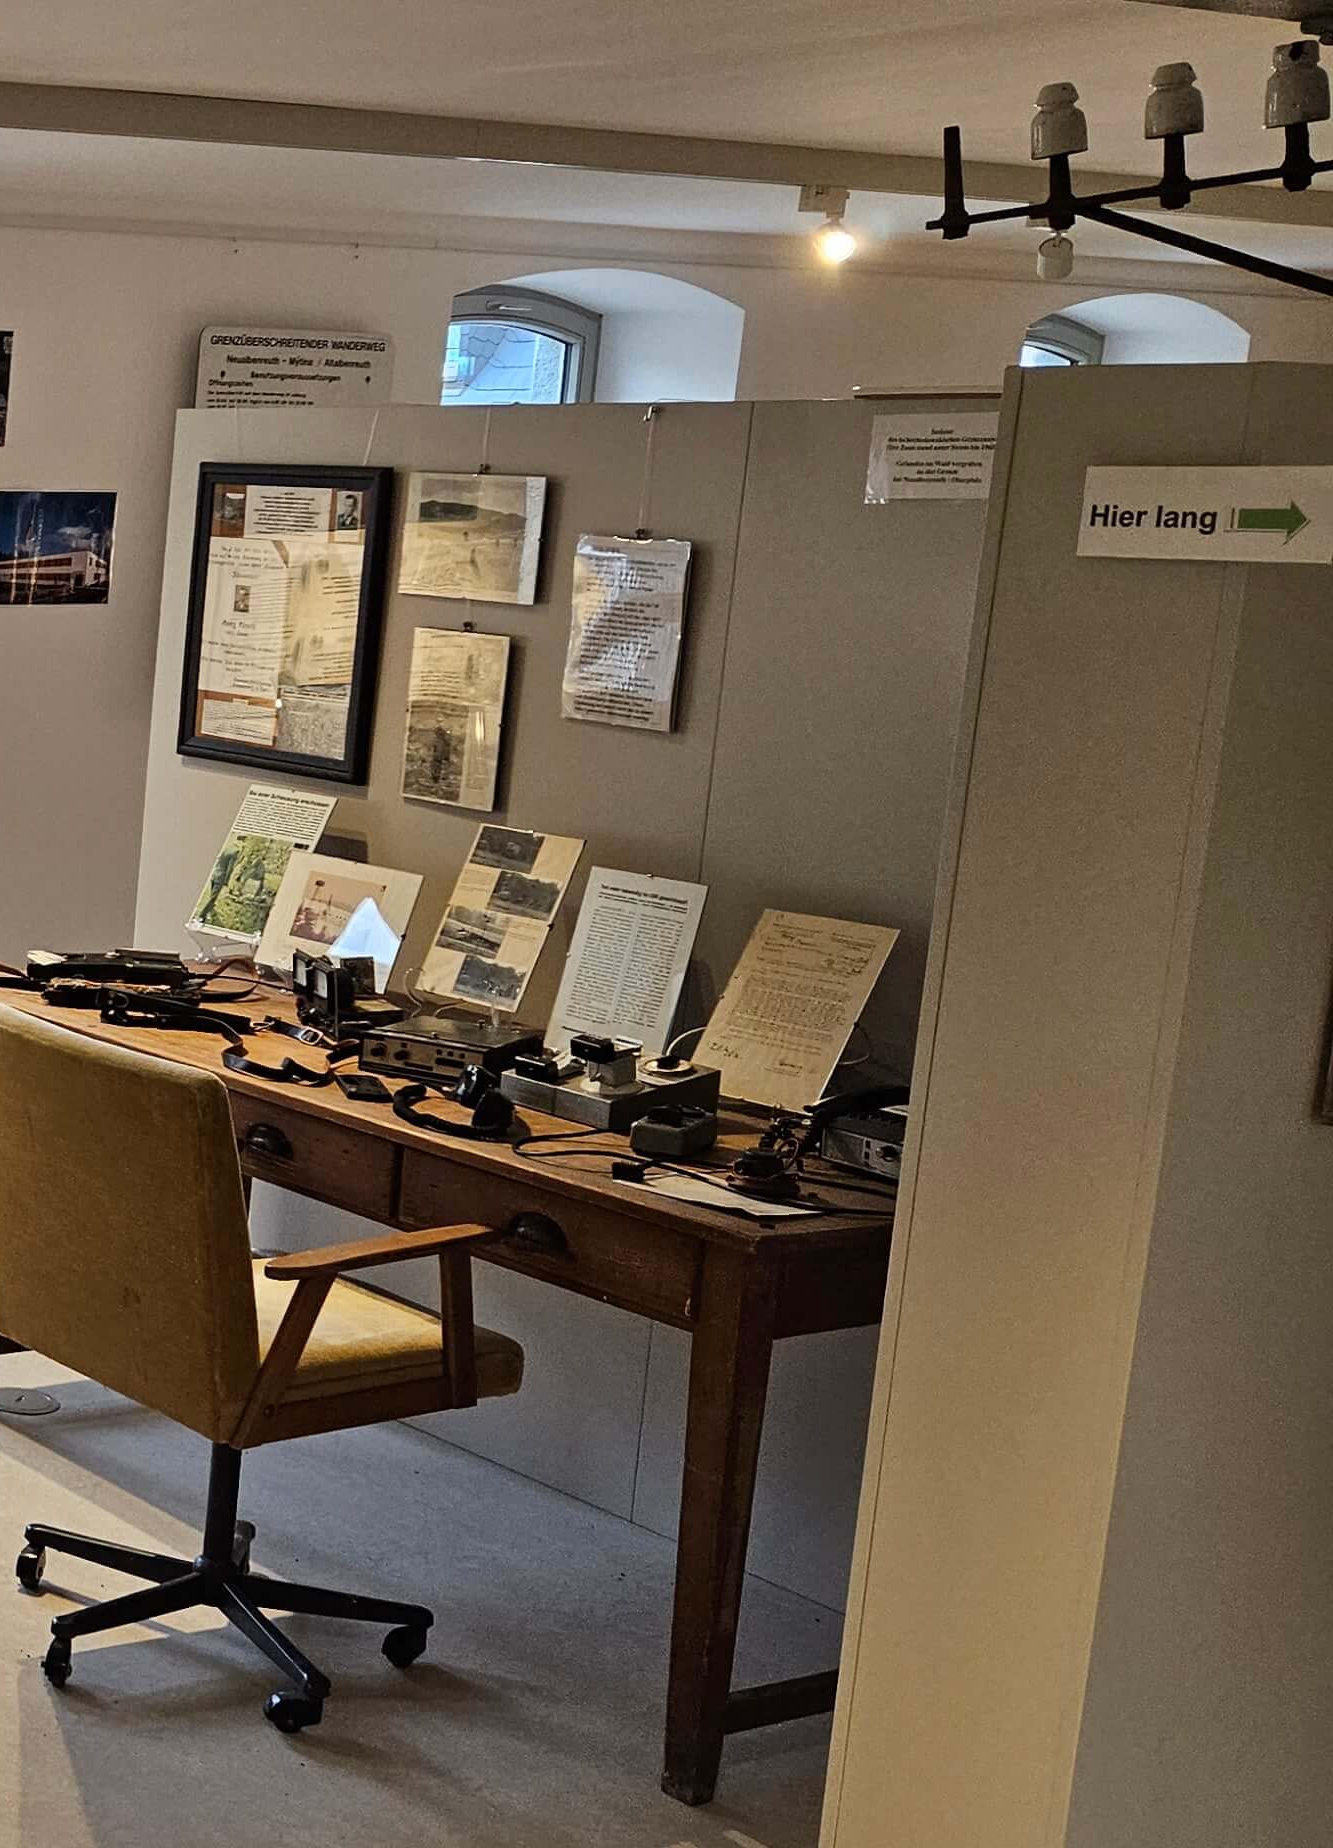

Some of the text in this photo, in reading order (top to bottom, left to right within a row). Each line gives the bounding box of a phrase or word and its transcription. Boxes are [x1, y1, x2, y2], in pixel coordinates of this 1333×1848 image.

[210, 334, 386, 352] GRENZÜBERSCHREITENDER WANDERWEG
[1089, 504, 1218, 535] Hier lang
